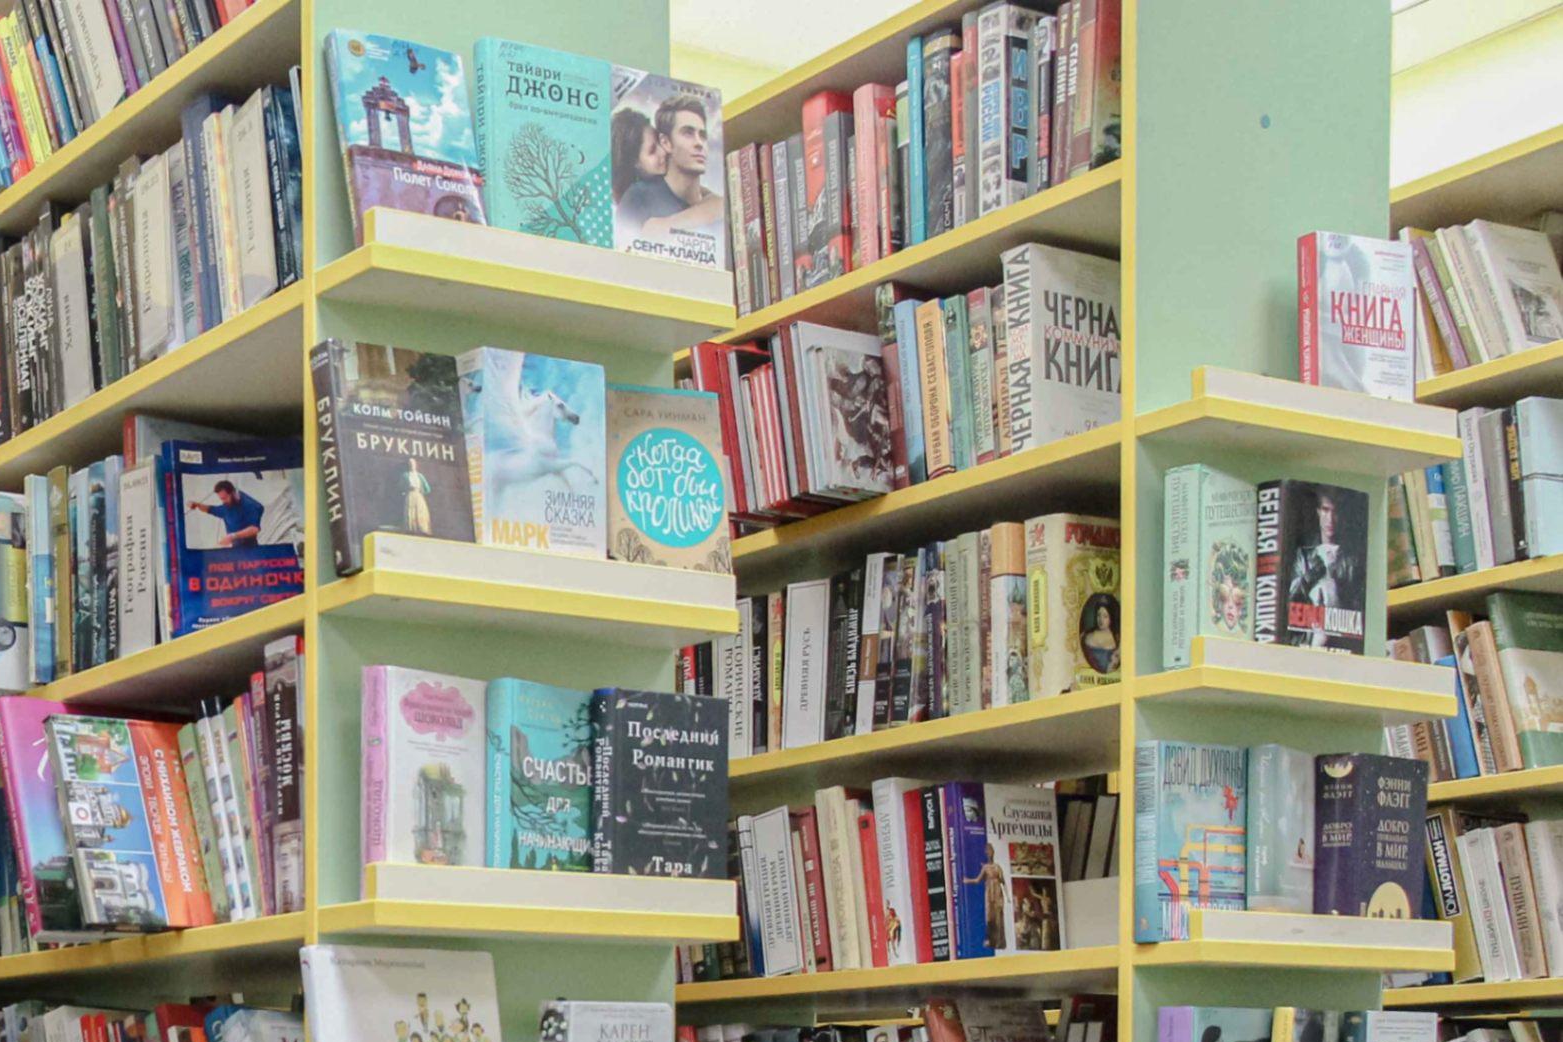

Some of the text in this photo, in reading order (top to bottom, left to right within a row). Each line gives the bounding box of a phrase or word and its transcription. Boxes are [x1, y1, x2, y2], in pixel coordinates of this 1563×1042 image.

[506, 60, 561, 81] тайари
[505, 74, 600, 111] ДЖОНС
[393, 167, 433, 189] Полет
[632, 240, 717, 265] СЕНТ-КЛАУДА
[678, 235, 716, 252] ЧАРЛИ
[1330, 291, 1402, 329] КНИГА
[14, 296, 30, 391] ВСЕЛЕННАЯ
[1008, 247, 1032, 452] ЧЕРНАЯ КНИГА
[1342, 329, 1405, 350] ЖЕНЩИНЫ
[353, 403, 451, 428] КОЛМ ТОЙБИН
[624, 408, 651, 421] САРА
[356, 432, 455, 461] БРУКЛИН
[636, 434, 705, 471] Когда
[317, 396, 342, 523] БРУКЛИН
[544, 490, 596, 511] ЗИМНЯЯ
[544, 508, 596, 528] СКАЗКА
[491, 519, 551, 549] МАРК
[237, 557, 297, 570] ПАРУСОМ
[1255, 487, 1280, 643] БЕЛАЯ КОШКА
[211, 594, 255, 608] ВОКРУГ
[1325, 611, 1362, 635] КОШКА
[627, 721, 718, 746] Последний
[631, 749, 715, 772] Романтик
[1164, 745, 1197, 787] ДЭВИД
[1378, 777, 1411, 790] ФЭННИ
[546, 797, 571, 813] ДЛЯ
[1378, 793, 1411, 808] ФЛЭГГ
[1003, 806, 1052, 821] Служанка
[158, 760, 192, 892] МИХАИЛОМ ЖЕБРАКОМ
[990, 816, 1053, 838] Артемиды
[1378, 820, 1409, 834] ДОБРО
[653, 855, 693, 875] Тара
[599, 1023, 650, 1040] КАРЕН
